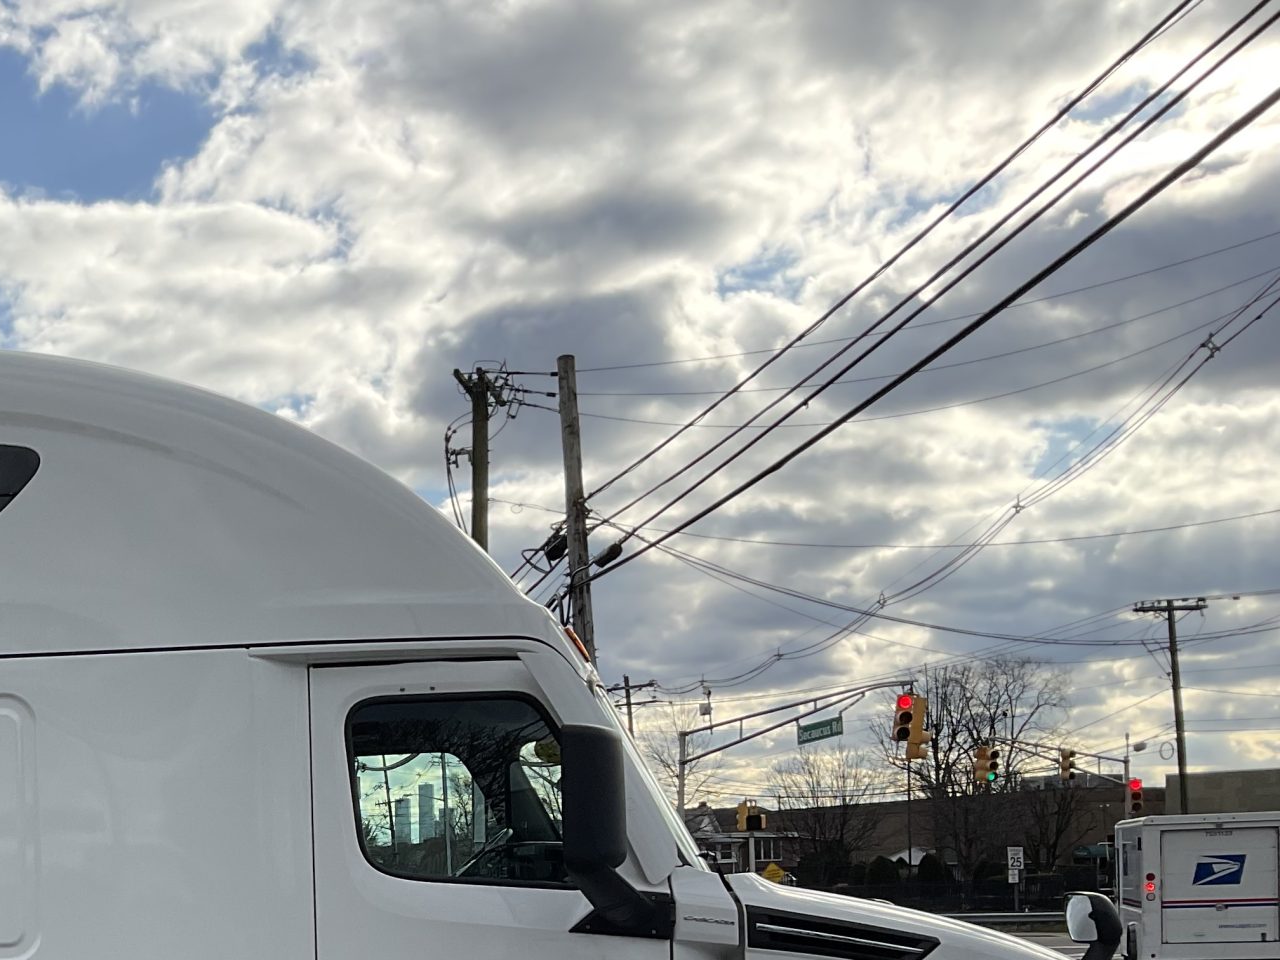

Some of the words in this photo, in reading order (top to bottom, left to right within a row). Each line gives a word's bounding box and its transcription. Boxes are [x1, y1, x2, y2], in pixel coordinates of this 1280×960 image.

[799, 725, 831, 742] Secaucus
[832, 719, 842, 734] Rd
[1010, 856, 1022, 868] 25
